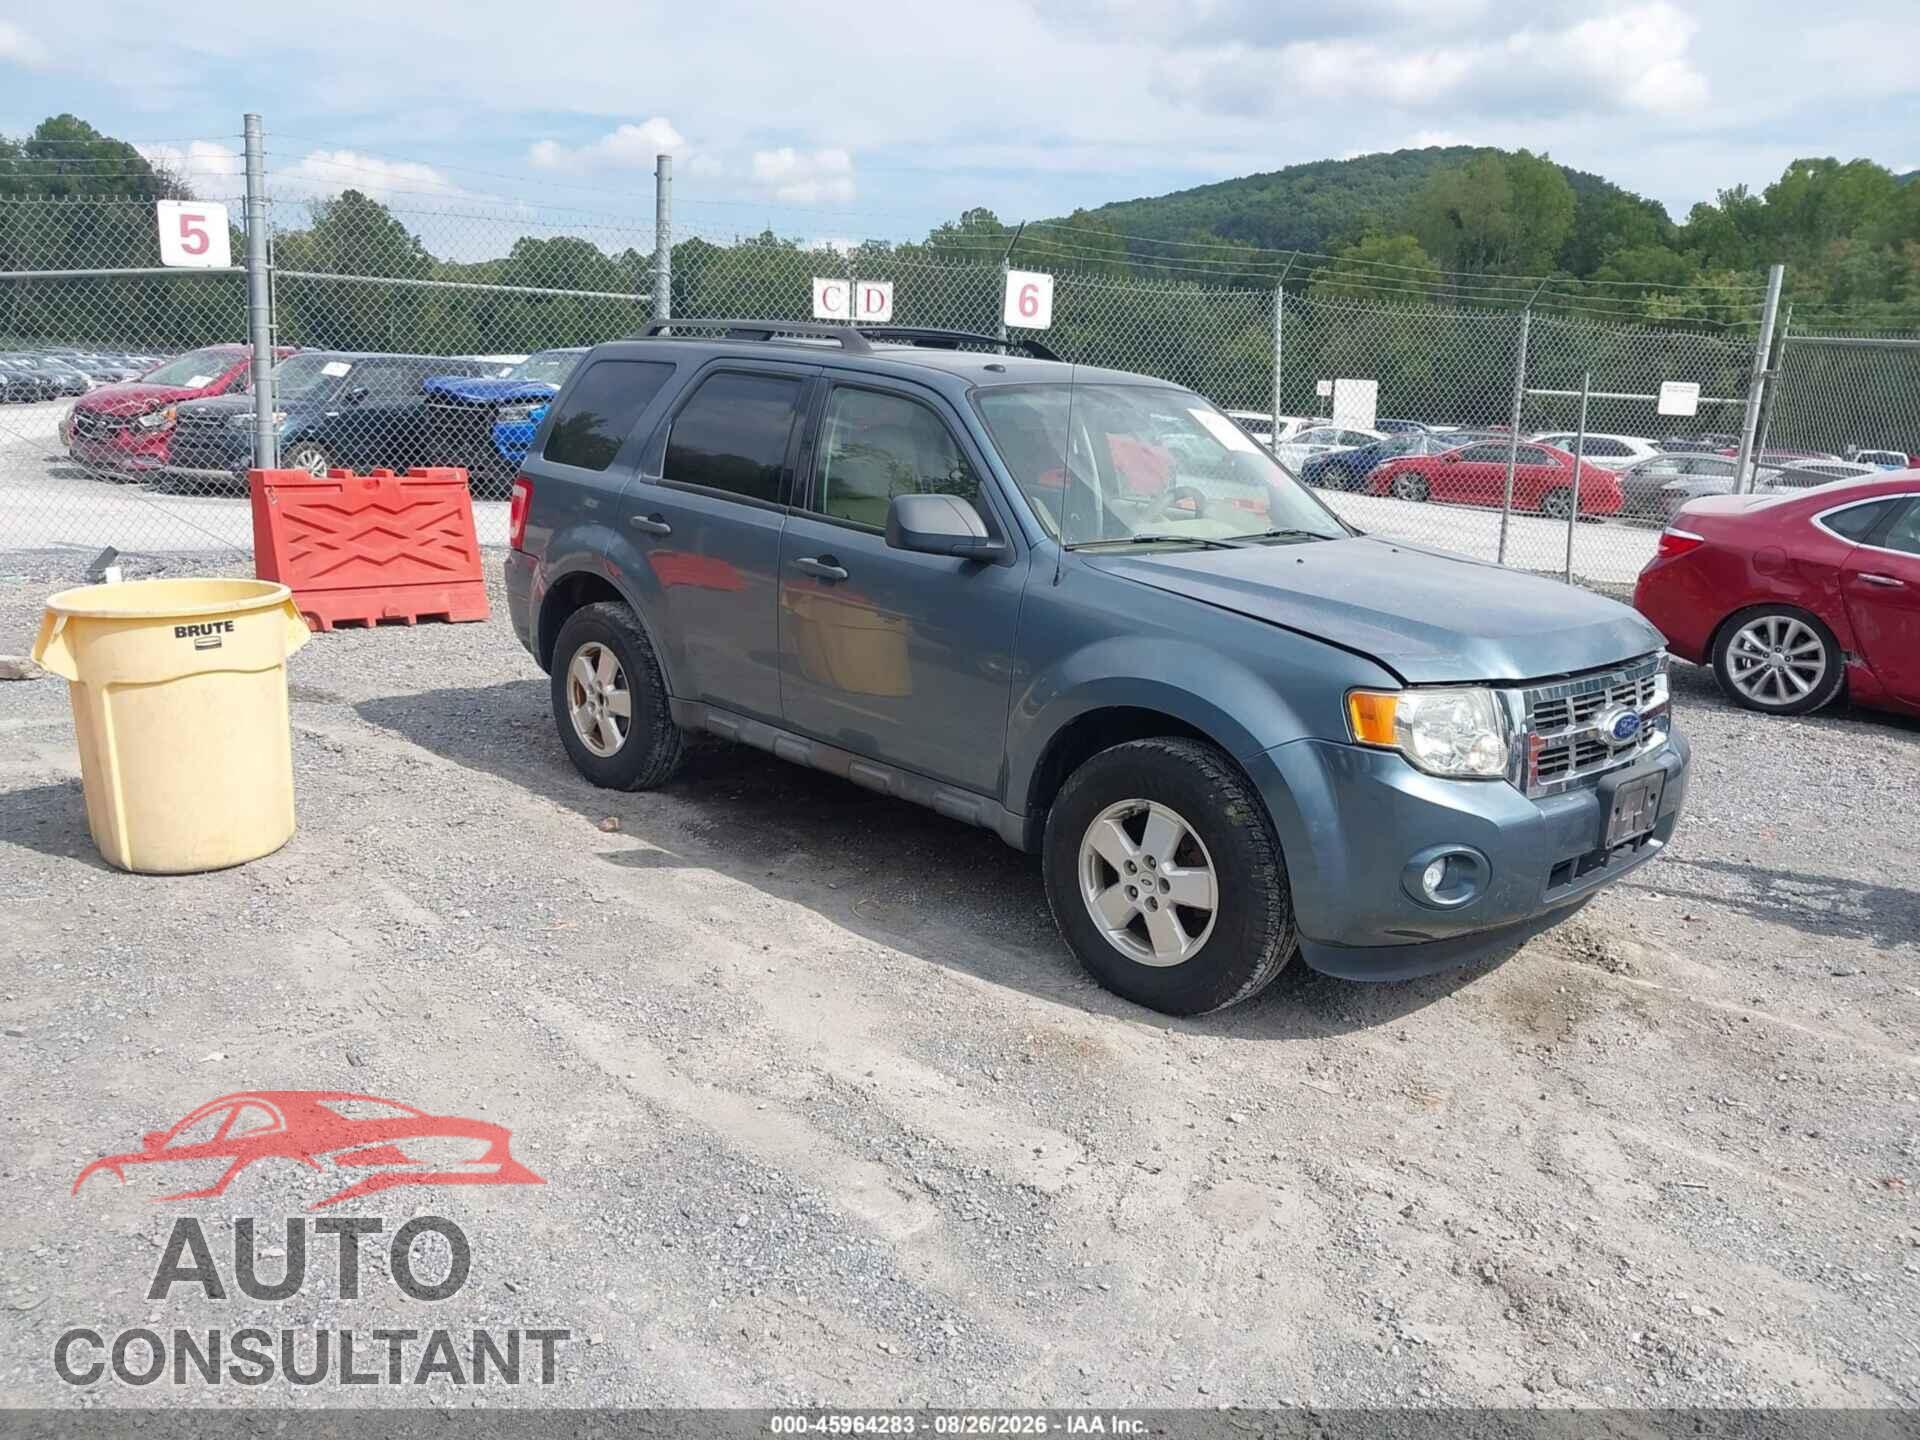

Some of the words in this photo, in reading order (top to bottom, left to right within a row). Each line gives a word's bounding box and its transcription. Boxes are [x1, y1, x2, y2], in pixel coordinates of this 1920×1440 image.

[179, 213, 210, 255] 5
[822, 286, 841, 312] C
[865, 288, 885, 313] D
[1018, 283, 1039, 317] 6
[174, 620, 235, 639] BRUTE
